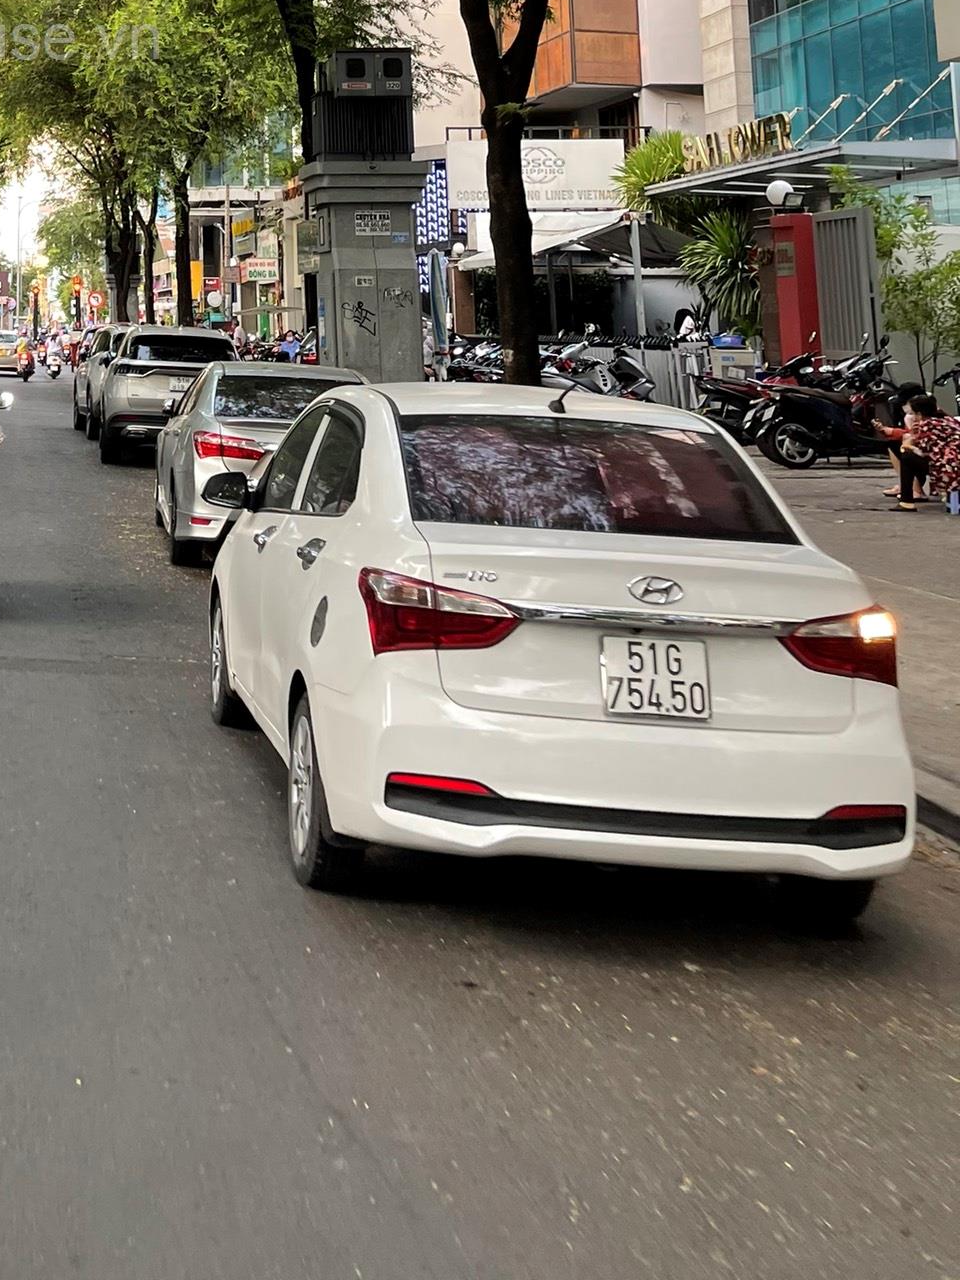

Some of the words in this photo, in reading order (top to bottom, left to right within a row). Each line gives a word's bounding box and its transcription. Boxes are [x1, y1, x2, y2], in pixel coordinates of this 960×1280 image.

[722, 111, 794, 164] TOWER
[521, 158, 565, 168] OSCO
[545, 189, 574, 201] LINES
[627, 640, 682, 676] 51G
[608, 676, 706, 715] 754.50
